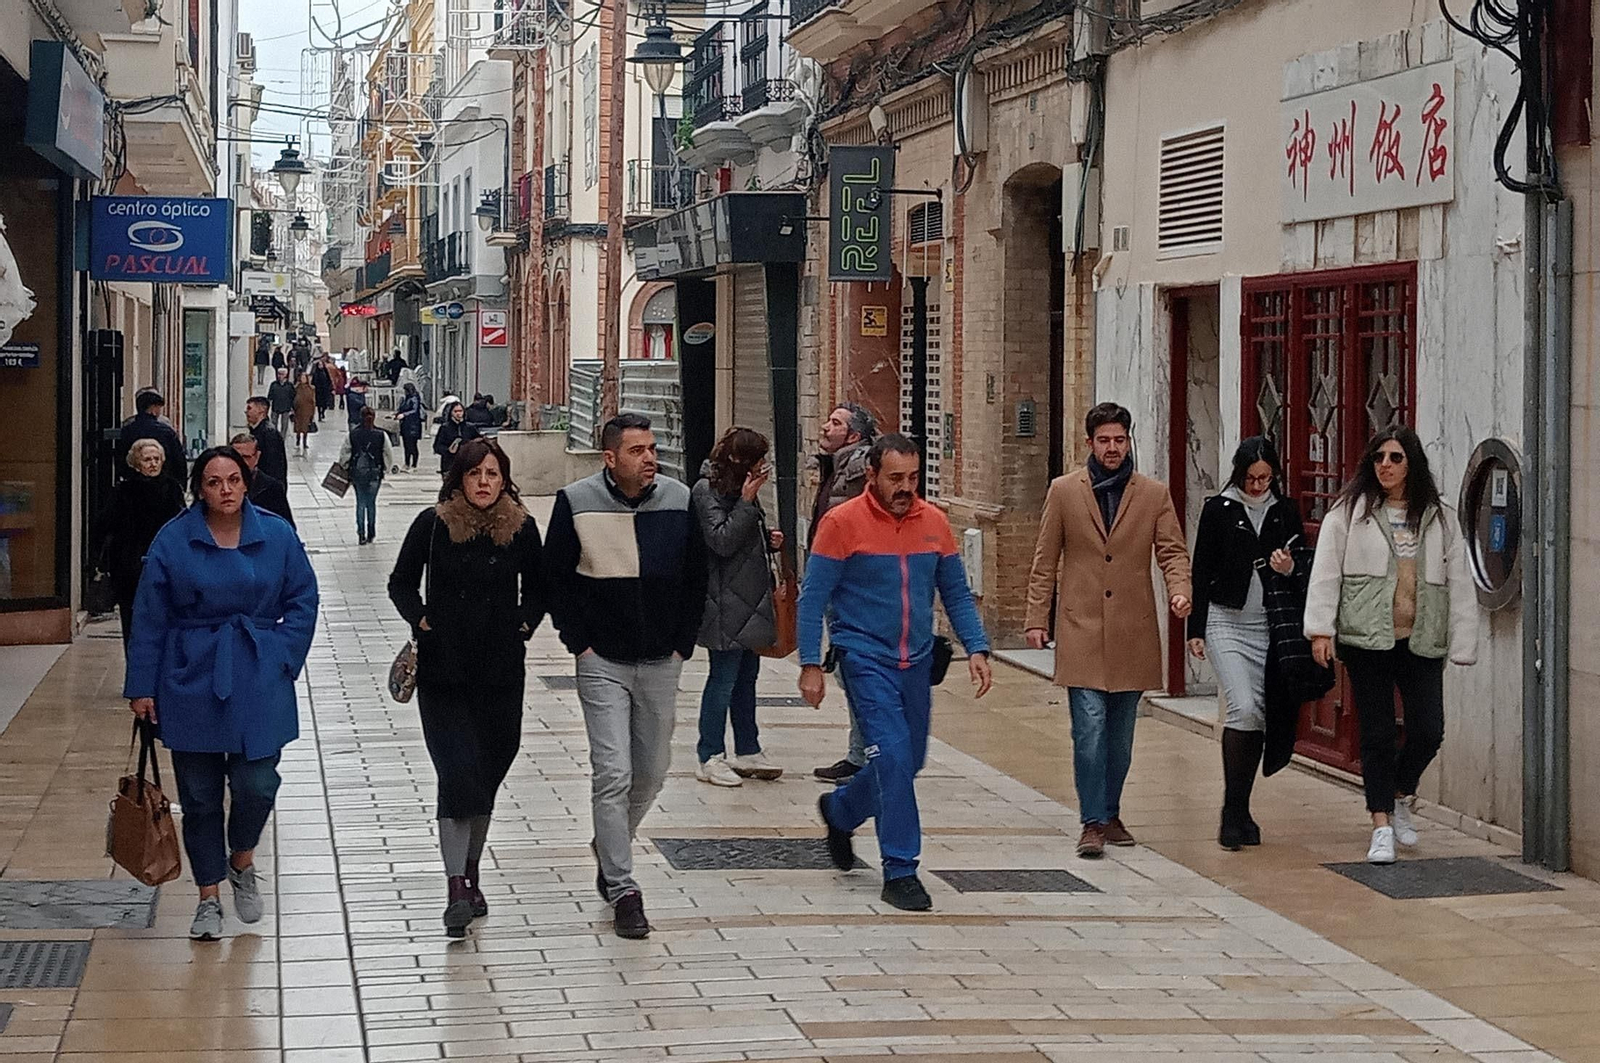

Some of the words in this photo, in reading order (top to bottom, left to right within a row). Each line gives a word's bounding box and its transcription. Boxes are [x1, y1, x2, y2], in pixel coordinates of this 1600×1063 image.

[1285, 83, 1448, 203] 神州饭店
[108, 200, 157, 216] centro
[161, 201, 211, 220] óptico
[841, 156, 880, 272] REEL
[104, 254, 211, 275] PASCUAL
